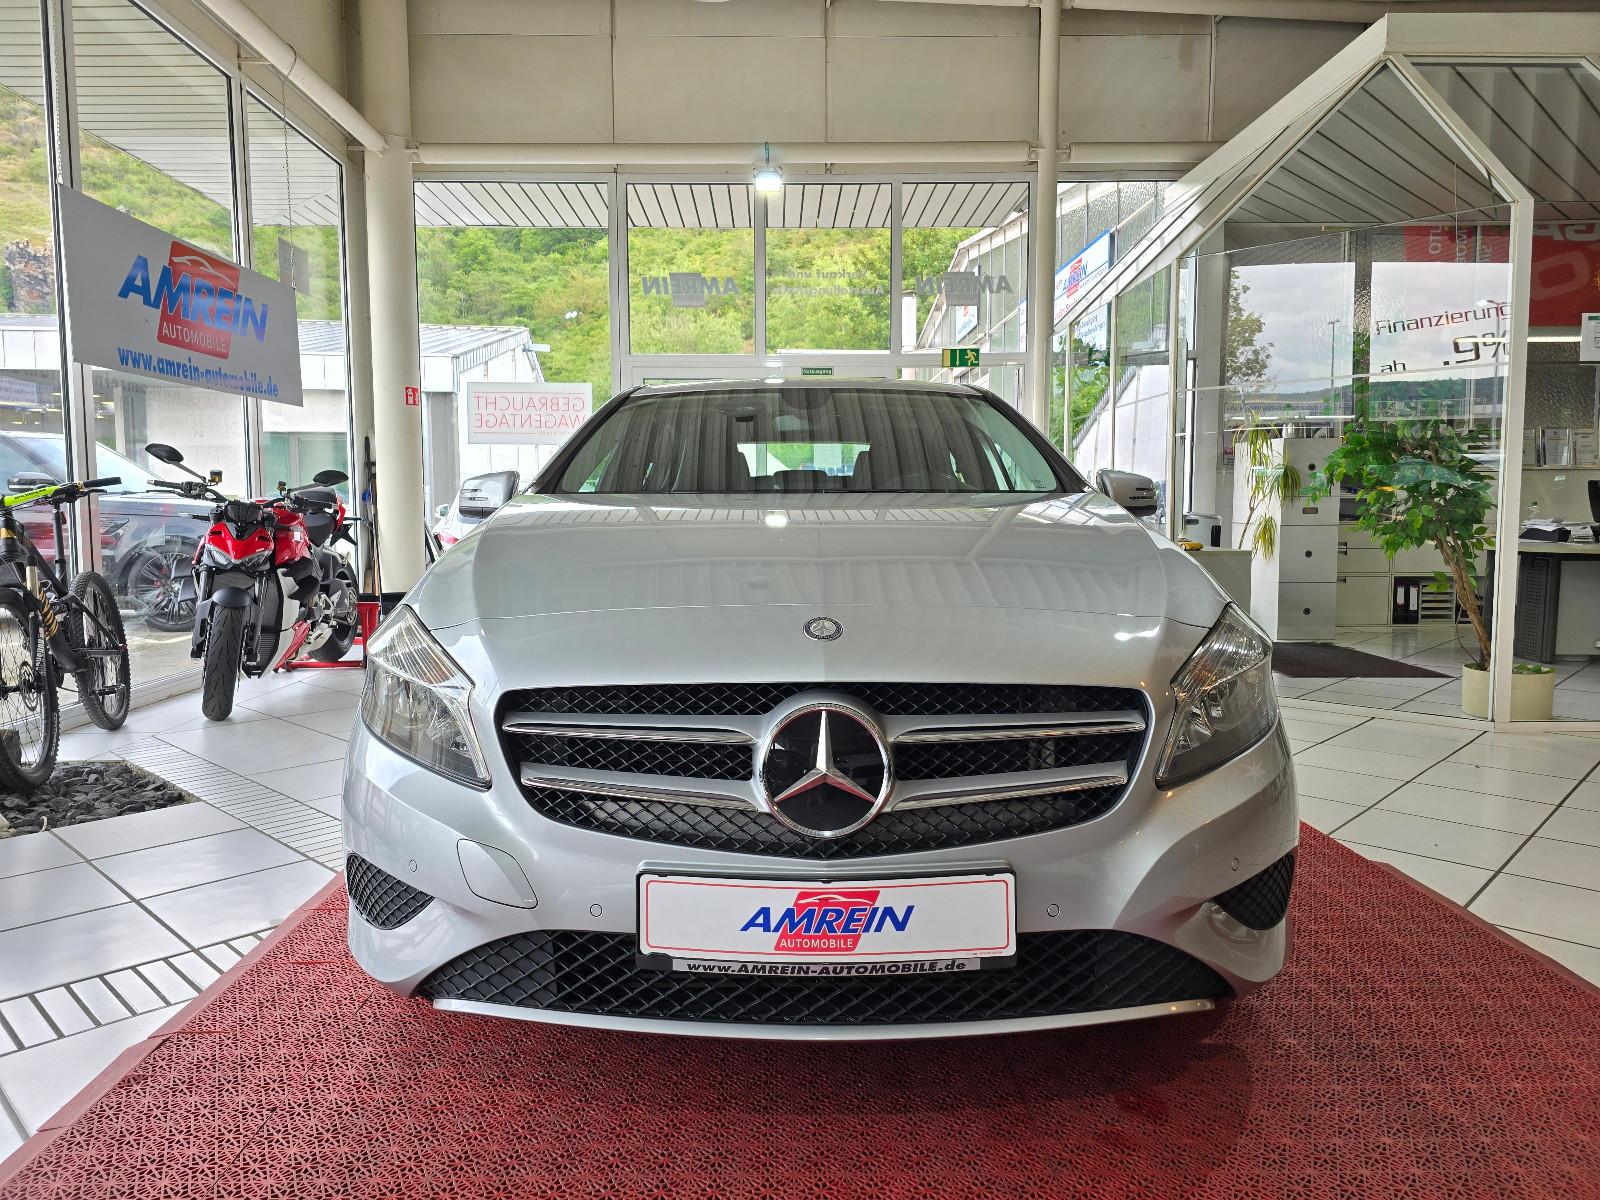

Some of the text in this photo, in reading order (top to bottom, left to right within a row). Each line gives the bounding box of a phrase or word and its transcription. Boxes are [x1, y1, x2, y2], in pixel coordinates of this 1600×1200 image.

[117, 254, 269, 343] AMREIN
[162, 321, 228, 353] AUTOMOBILE
[116, 346, 280, 398] www.amrein-automobile.de
[739, 904, 915, 935] AMREIN
[779, 937, 854, 949] AUTOMOBILE
[686, 960, 967, 976] www.AMREIN-AUTOMOBILE.de
